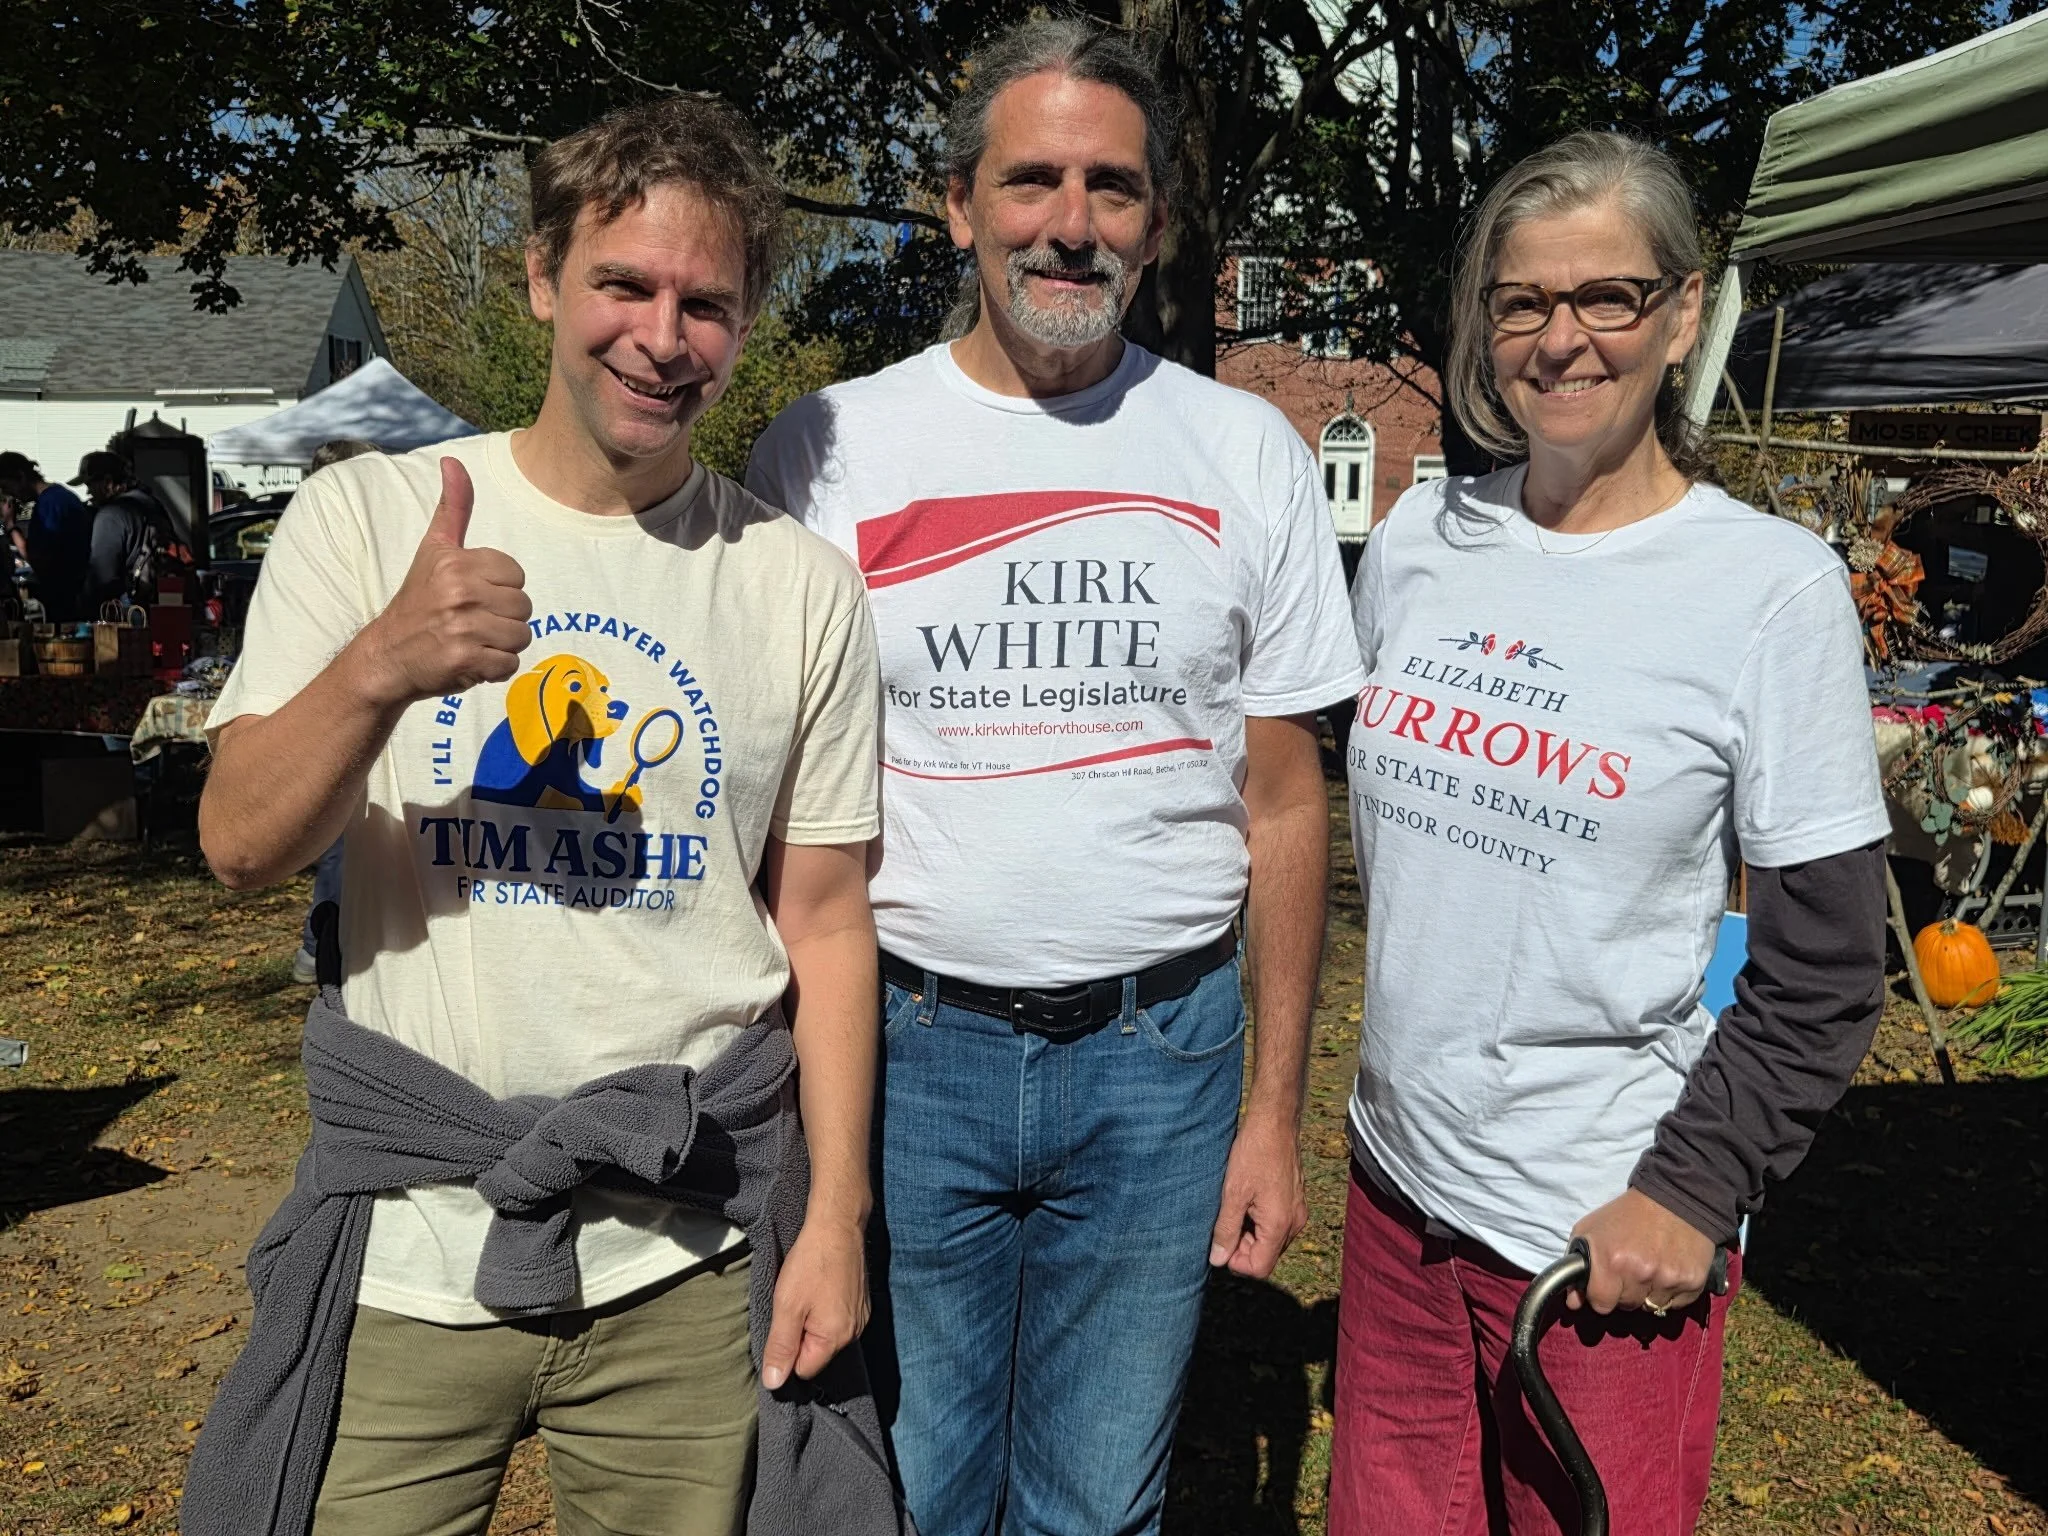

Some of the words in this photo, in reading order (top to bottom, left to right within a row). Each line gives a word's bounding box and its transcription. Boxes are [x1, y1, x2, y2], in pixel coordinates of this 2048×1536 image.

[1858, 423, 1948, 442] MOSEY
[1956, 424, 2033, 443] CREEK
[1001, 559, 1160, 606] KIRK
[916, 620, 1160, 672] WHITE
[888, 684, 921, 708] for
[929, 684, 1011, 709] State
[1022, 681, 1187, 712] Legislature
[1401, 656, 1570, 713] ELIZABETH
[436, 694, 463, 727] BE
[527, 612, 667, 662] TAXPAYER
[669, 660, 722, 819] WATCHDOG
[937, 719, 1144, 737] www.kirkwhiteforvthouse.com
[913, 759, 921, 768] by
[960, 761, 969, 769] for
[972, 762, 983, 770] VT
[985, 762, 1011, 770] House
[1071, 771, 1086, 780] 307
[1177, 762, 1186, 770] VT
[1187, 760, 1208, 768] 05032
[1348, 745, 1367, 770] OR
[1376, 755, 1460, 798] STATE
[1472, 784, 1601, 842] SENATE
[420, 817, 531, 872] TIM
[544, 829, 708, 880] ASHE
[1447, 824, 1557, 875] COUNTY
[457, 876, 486, 902] FR
[495, 881, 565, 905] STATE
[571, 886, 675, 910] AUDITOR
